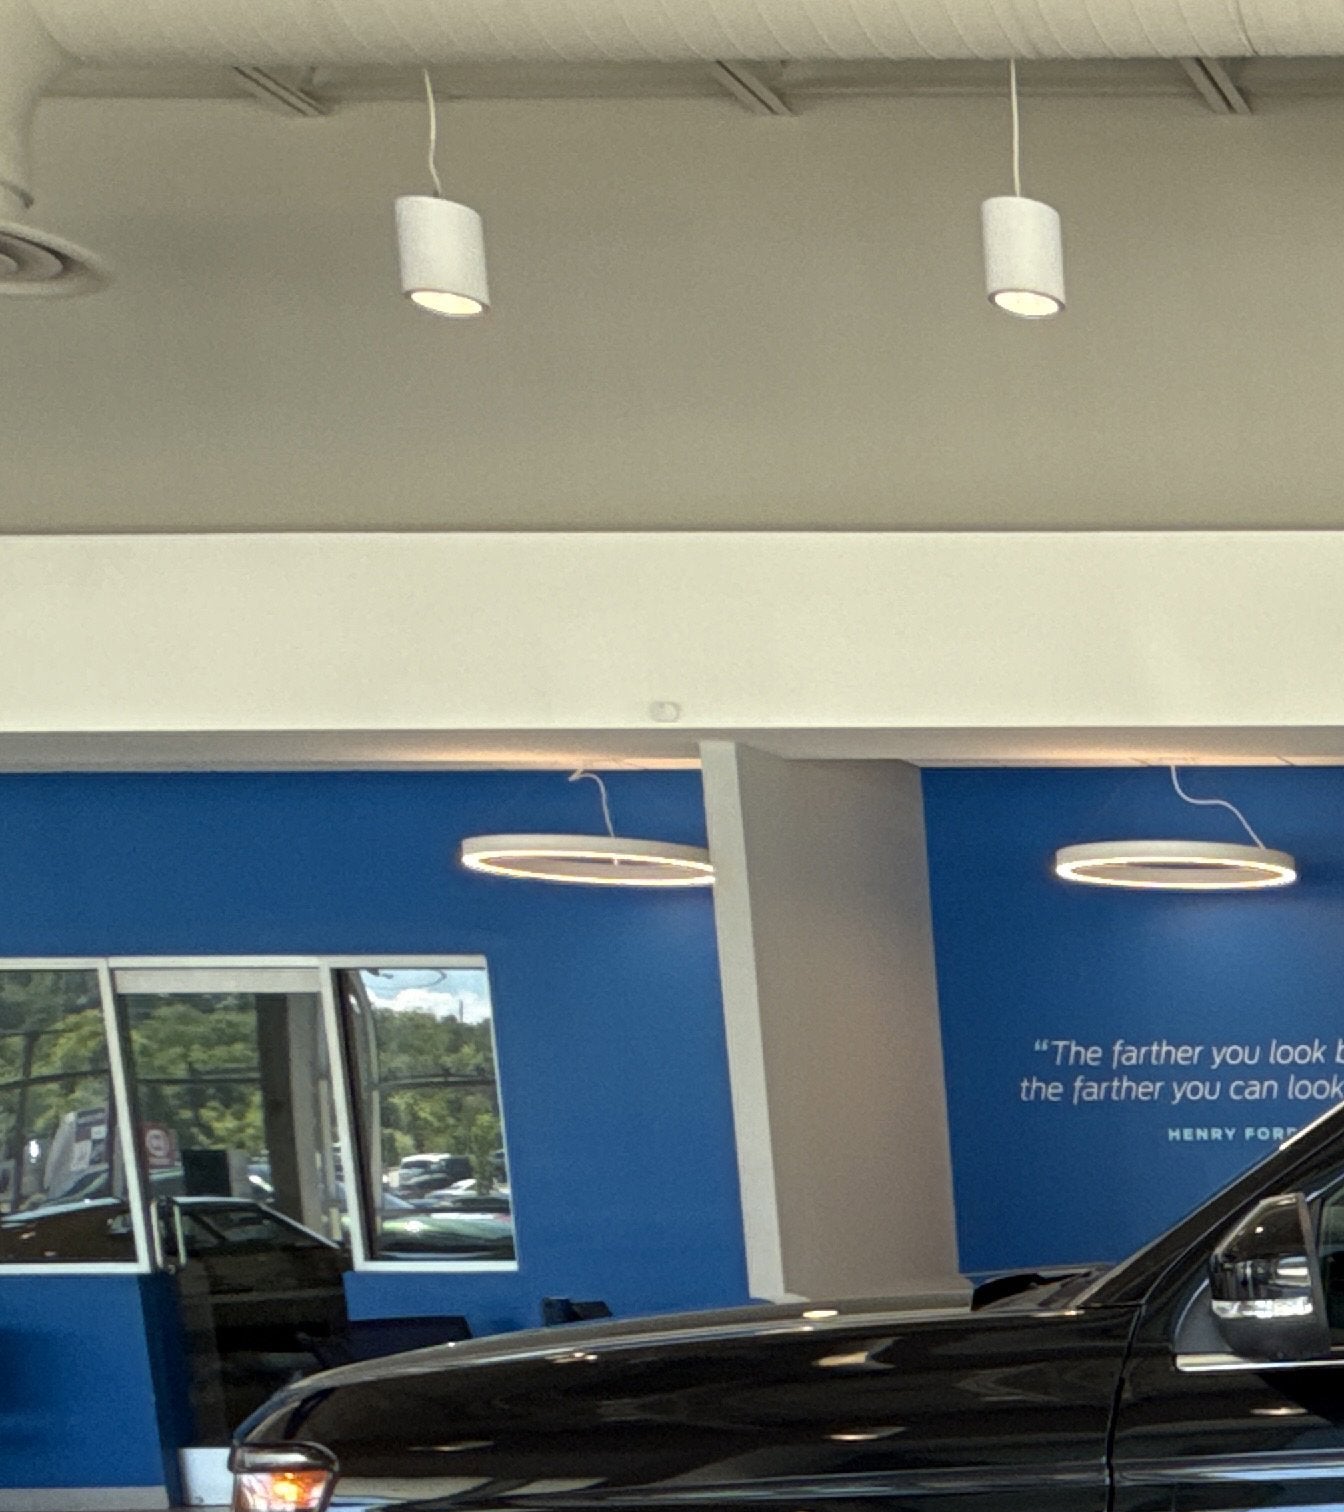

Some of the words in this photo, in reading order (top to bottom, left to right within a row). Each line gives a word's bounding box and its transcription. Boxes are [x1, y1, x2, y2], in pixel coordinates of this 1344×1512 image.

[1112, 1040, 1204, 1069] farther
[1210, 1045, 1260, 1070] you
[1269, 1039, 1327, 1066] look
[1020, 1077, 1064, 1102] the
[1073, 1075, 1164, 1105] farther
[1171, 1080, 1221, 1105] you
[1228, 1080, 1279, 1101] can
[1168, 1127, 1236, 1141] HENRY
